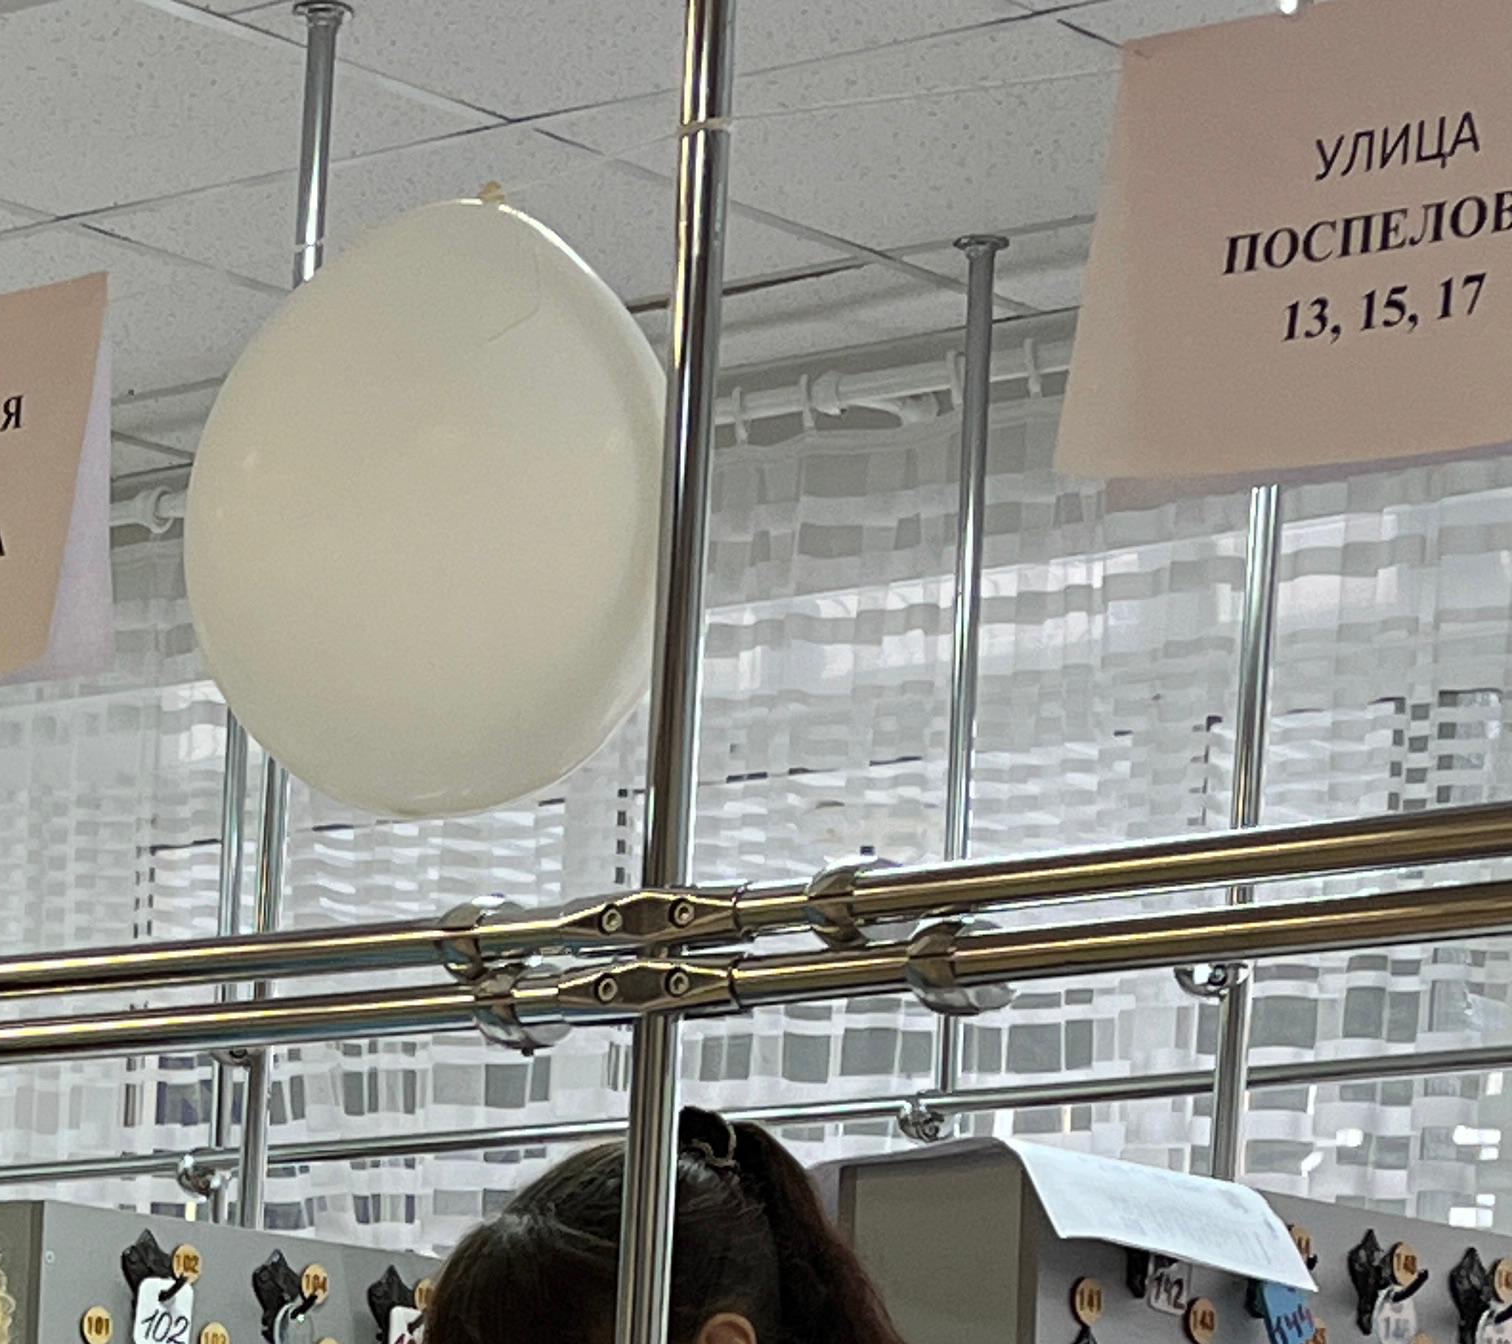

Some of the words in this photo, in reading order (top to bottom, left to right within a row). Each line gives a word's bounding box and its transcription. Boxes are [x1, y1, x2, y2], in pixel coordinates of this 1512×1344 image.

[1314, 111, 1481, 181] УЛИЦА
[1281, 297, 1342, 345] 13,
[1359, 286, 1419, 331] 15,
[1436, 272, 1487, 321] 17
[1154, 1271, 1186, 1310] 142
[87, 1316, 111, 1336] 101
